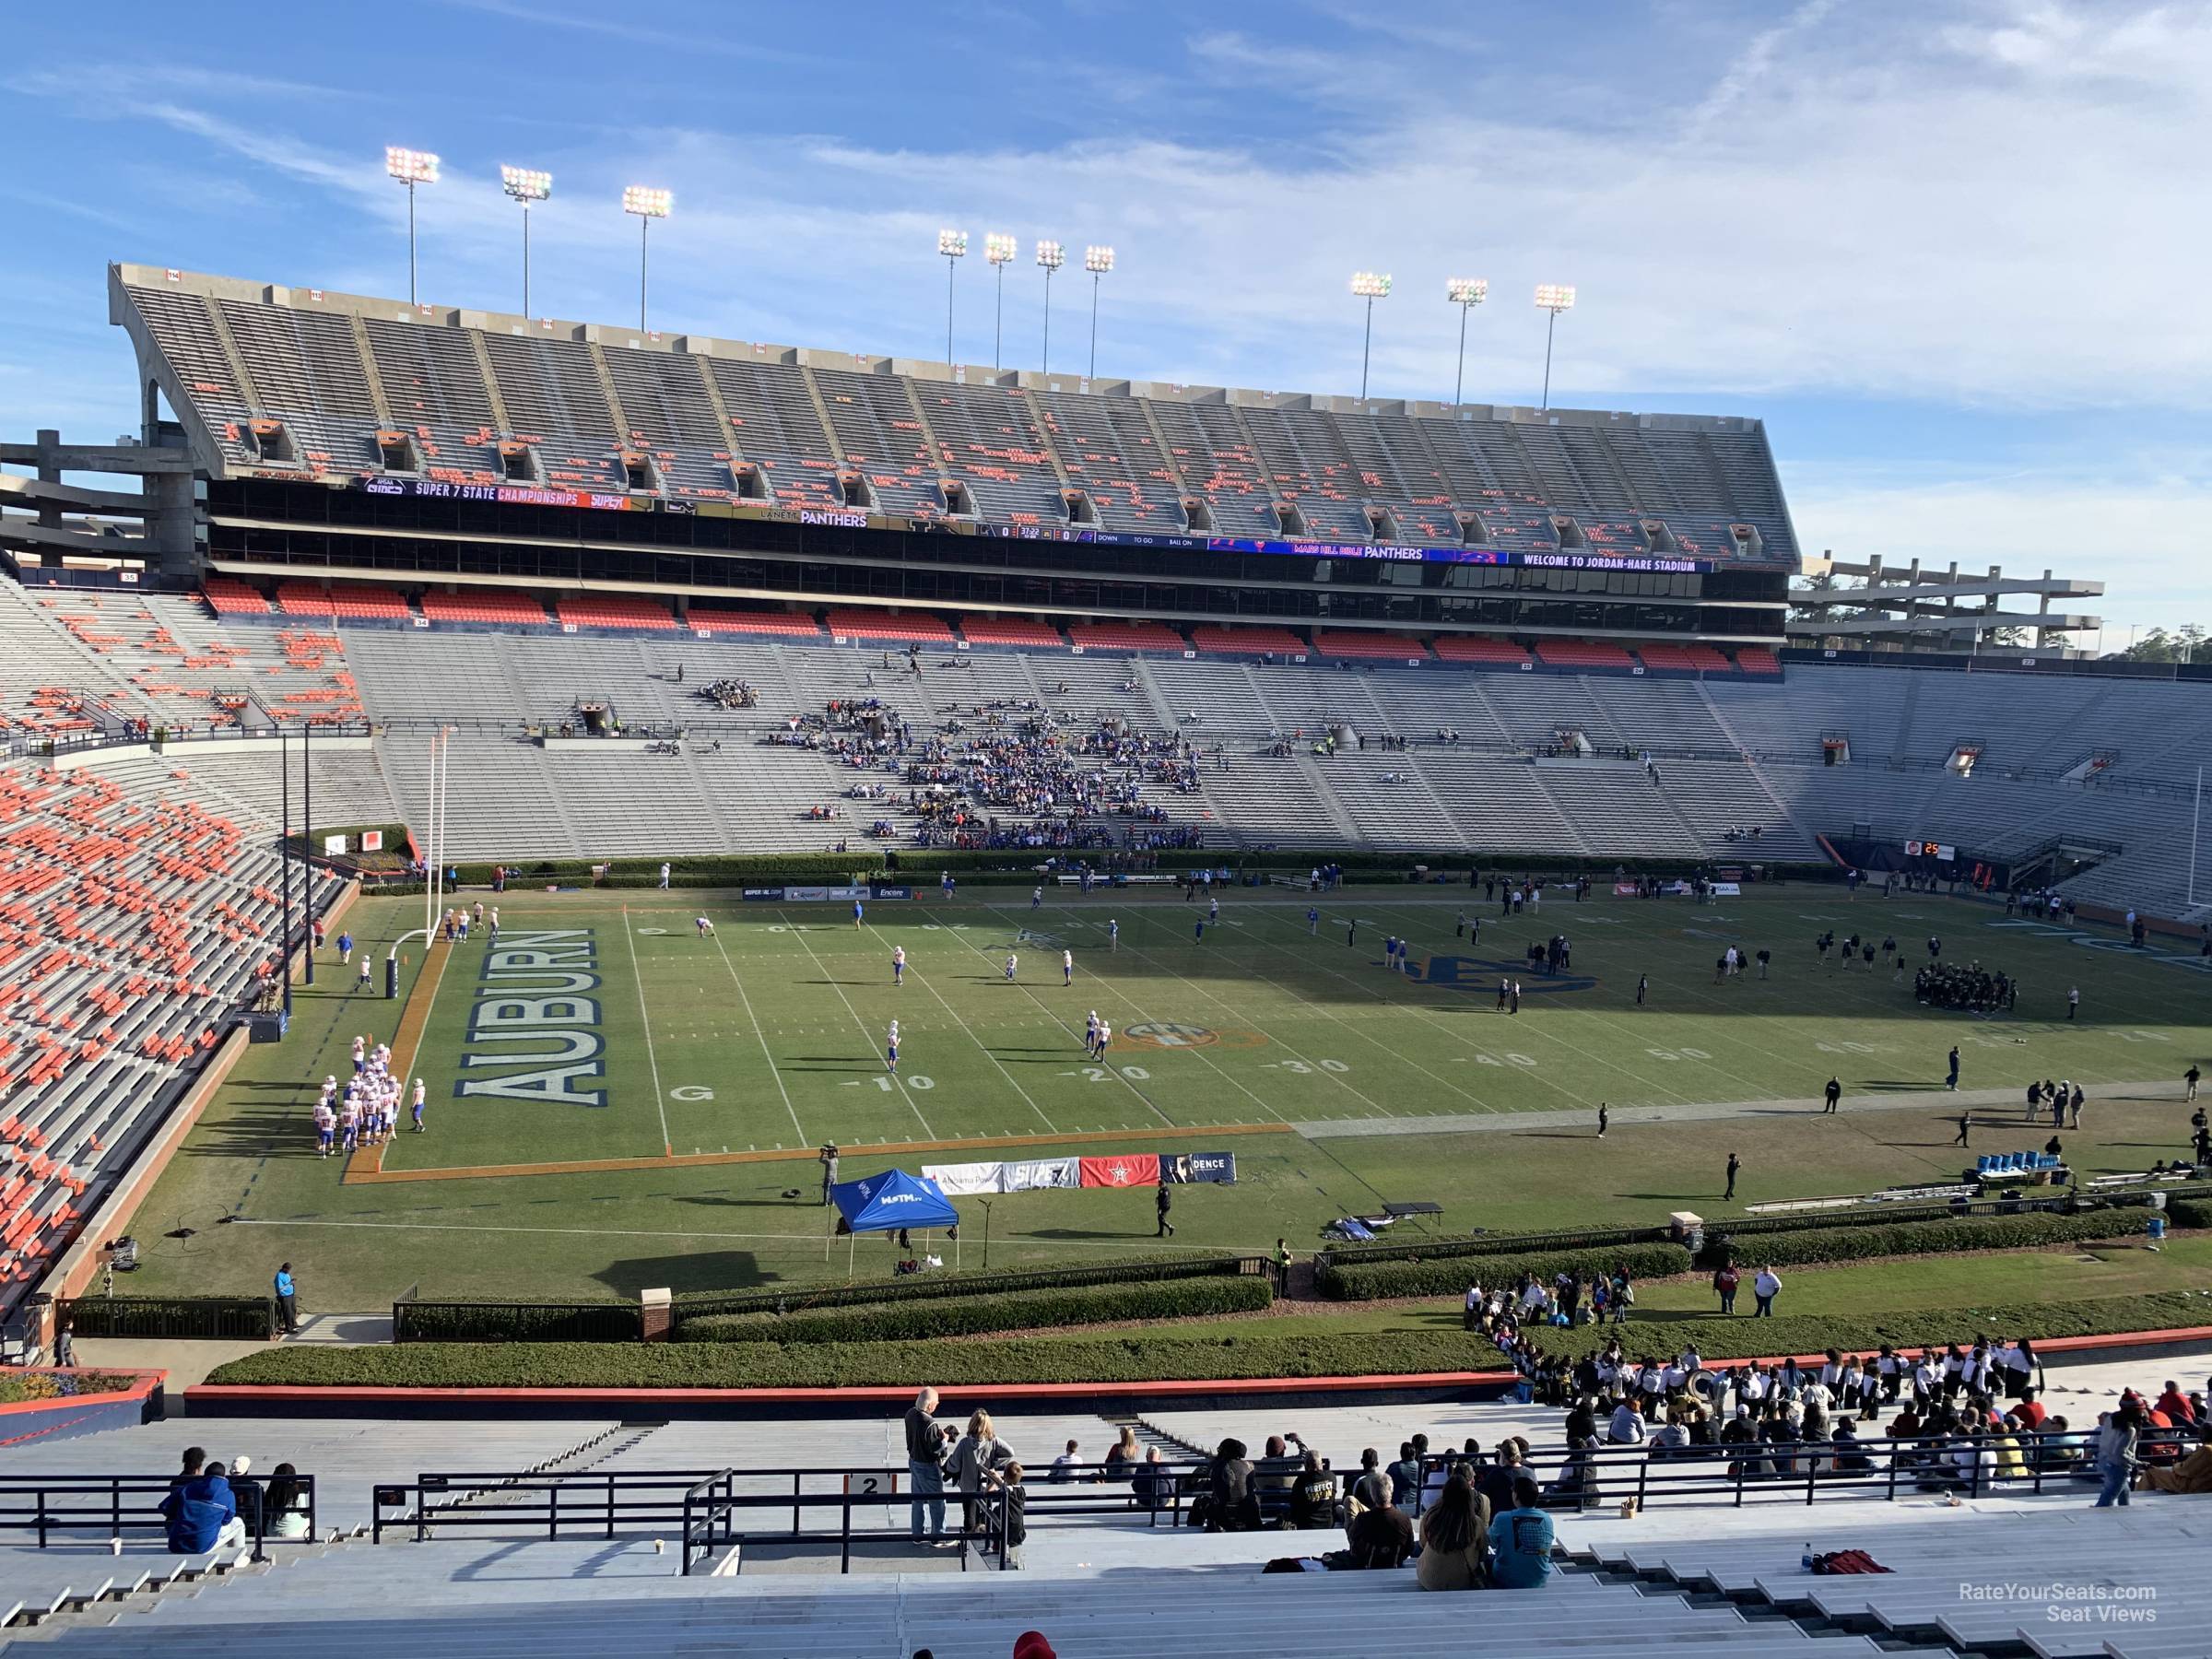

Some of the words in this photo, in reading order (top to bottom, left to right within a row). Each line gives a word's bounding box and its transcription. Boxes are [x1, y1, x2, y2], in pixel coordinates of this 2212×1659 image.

[416, 482, 449, 496] SUPER
[453, 486, 460, 497] 7
[463, 486, 495, 500] STATE
[498, 488, 578, 505] CHAMPIONSHIPS
[760, 510, 797, 520] LANETT
[801, 511, 867, 527] PANTHERS
[1001, 527, 1009, 536] 0
[1063, 531, 1070, 540] 0
[1294, 544, 1319, 553] MARS
[1320, 546, 1338, 554] HILL
[1364, 546, 1422, 559] PANTHERS
[1524, 554, 1569, 566] WELCOME
[1571, 557, 1584, 567] TO
[1586, 557, 1652, 571] JORDAN-HARE
[1654, 559, 1696, 571] STADIUM
[1925, 842, 1938, 854] 25
[457, 928, 605, 1106] AUBURN
[1475, 1053, 1538, 1067] 40
[1645, 1047, 1712, 1061] 50
[1082, 1065, 1151, 1082] 20
[1281, 1059, 1349, 1074] 30
[872, 1075, 935, 1092] 10
[669, 1085, 715, 1101] G
[864, 1477, 878, 1494] 2
[1304, 1481, 1333, 1494] PERFECT
